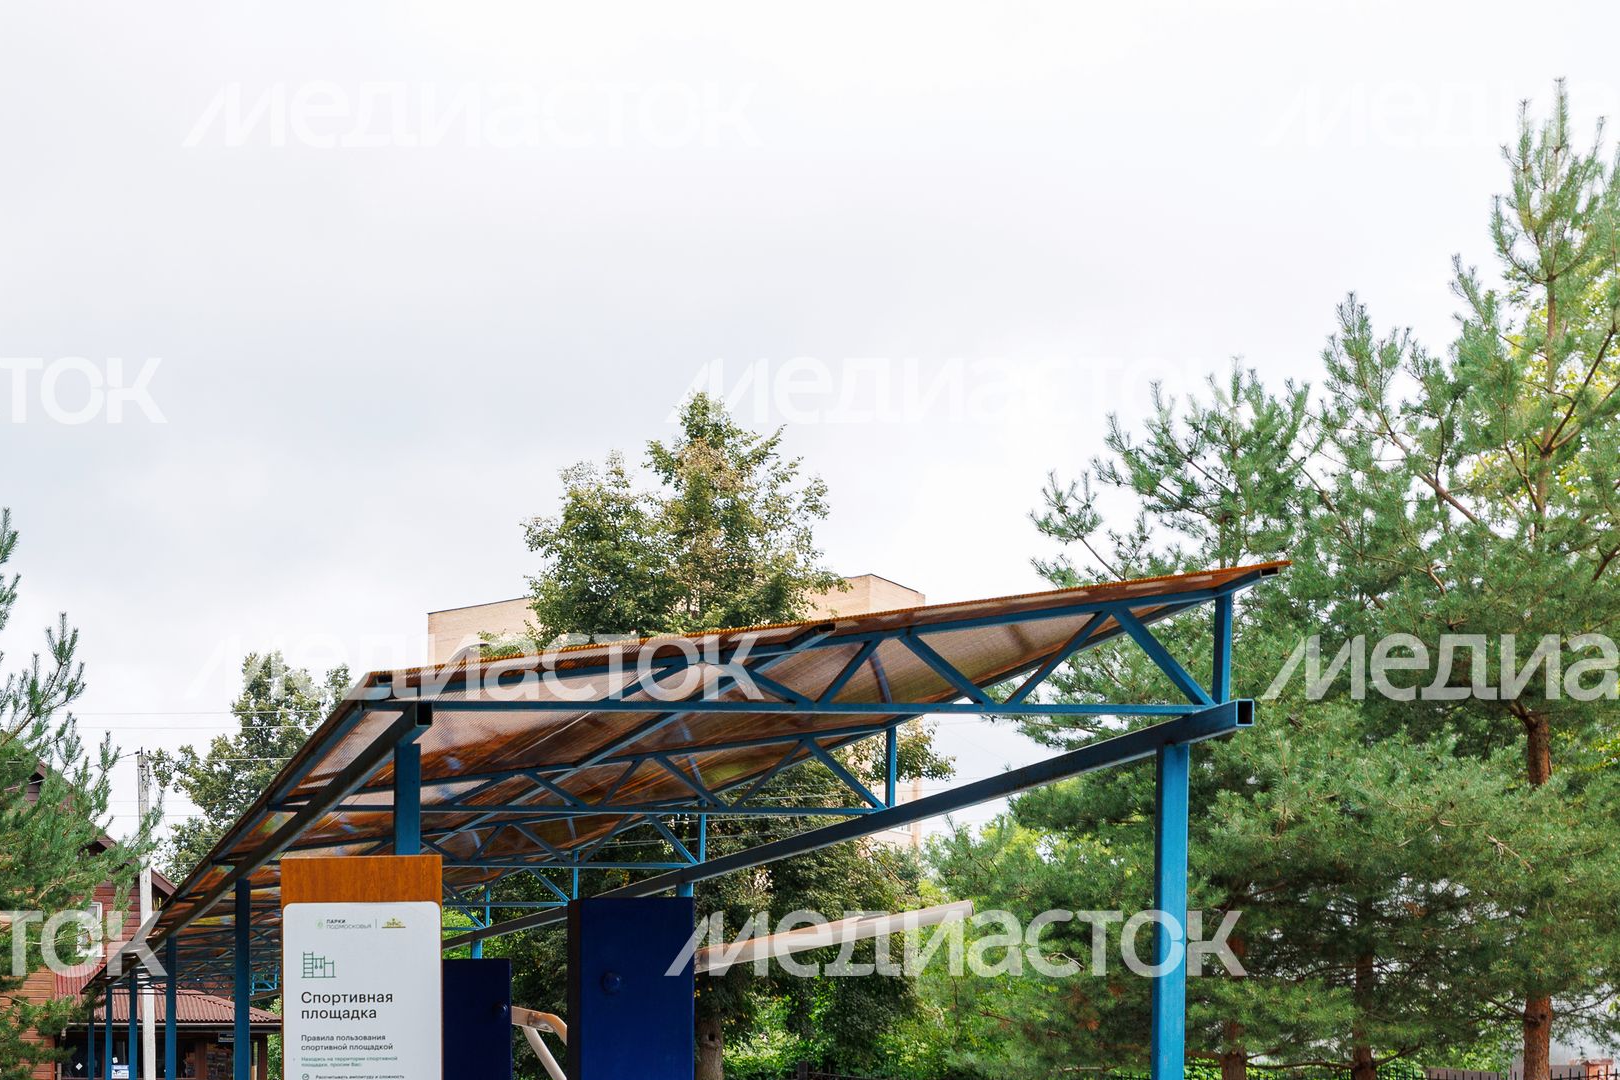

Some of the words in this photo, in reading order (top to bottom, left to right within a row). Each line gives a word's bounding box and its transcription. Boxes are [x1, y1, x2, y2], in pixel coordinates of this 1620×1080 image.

[301, 991, 393, 1006] Спортивная
[301, 1009, 377, 1021] площадка
[301, 1034, 335, 1042] Правила
[335, 1034, 386, 1042] пользования
[301, 1043, 348, 1051] спортивной
[348, 1043, 394, 1051] площадкой
